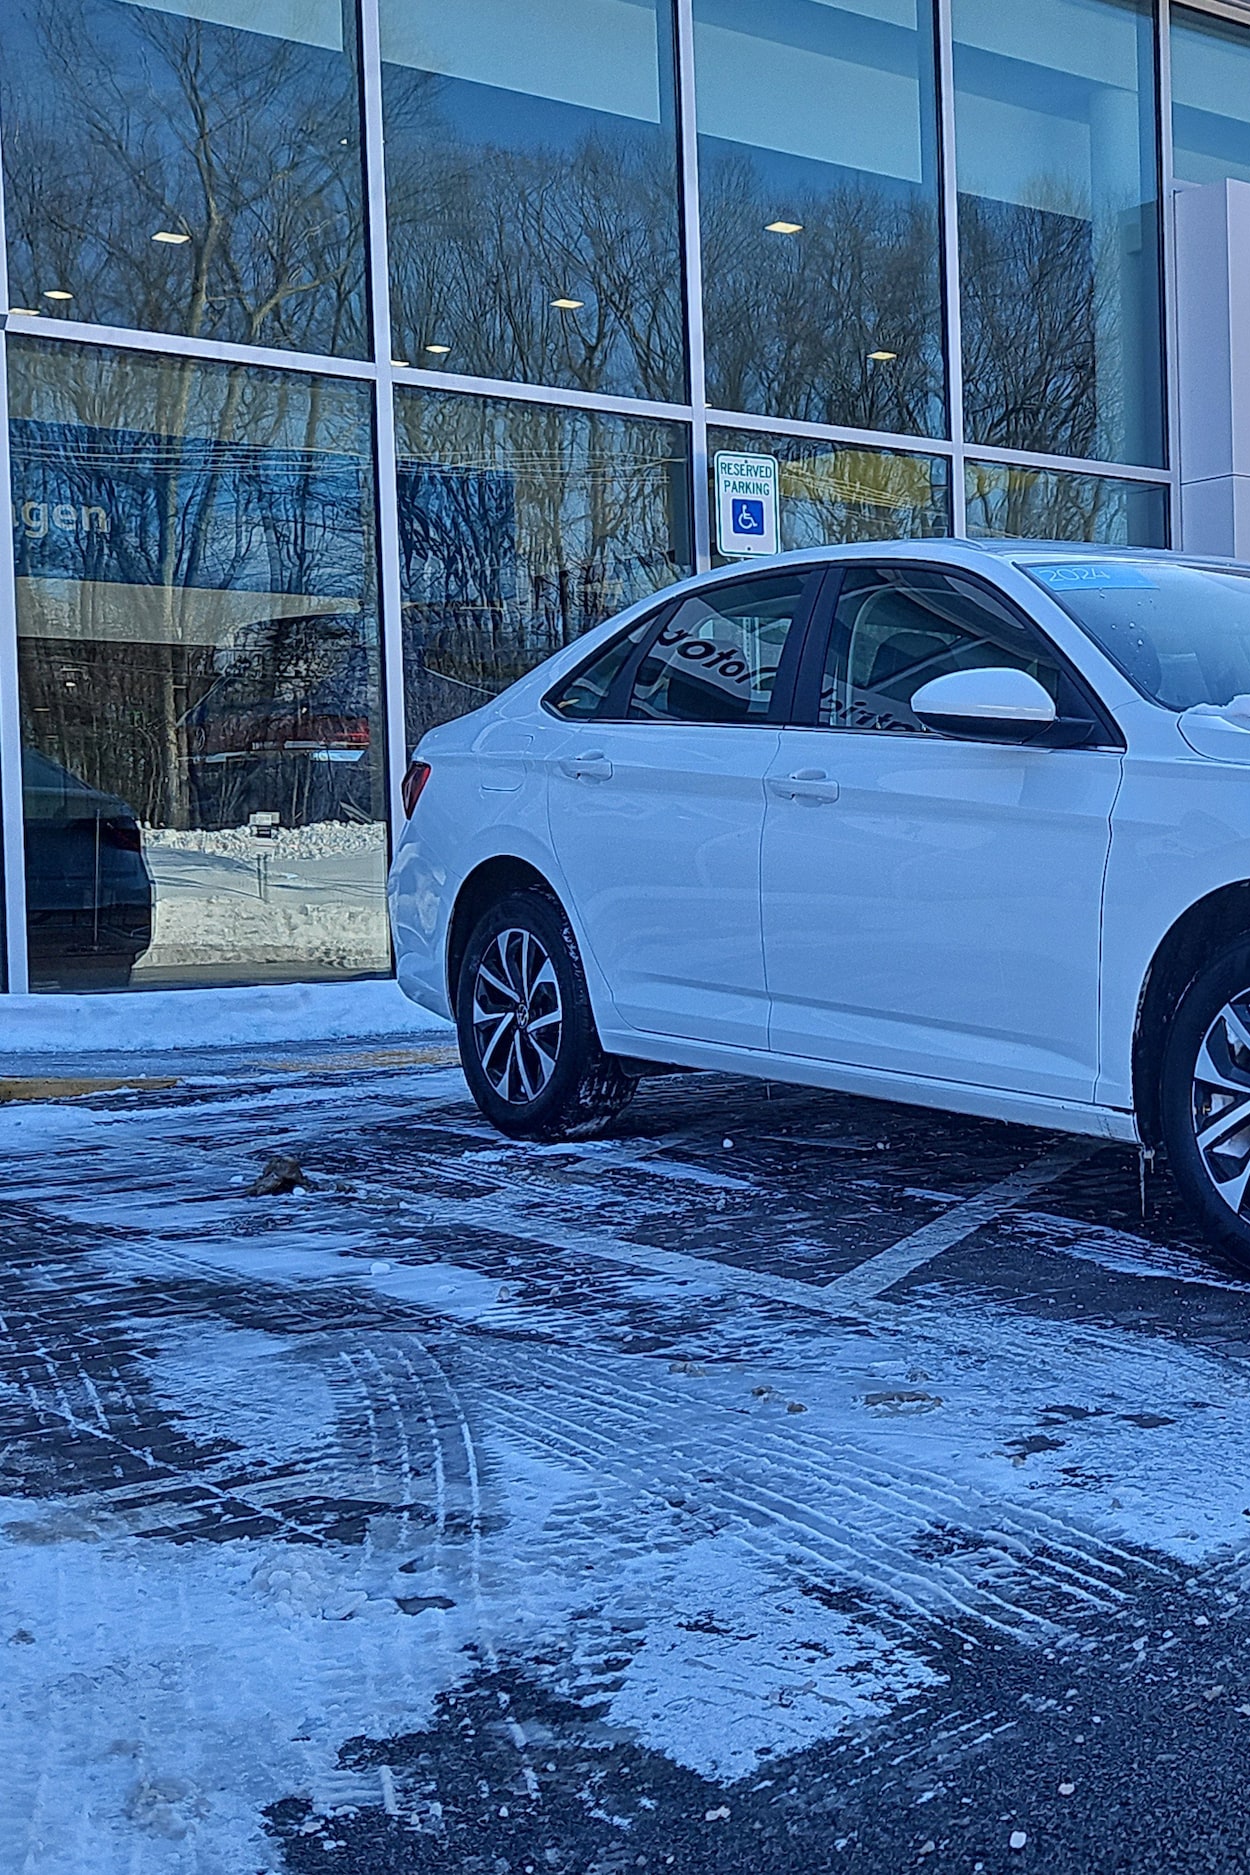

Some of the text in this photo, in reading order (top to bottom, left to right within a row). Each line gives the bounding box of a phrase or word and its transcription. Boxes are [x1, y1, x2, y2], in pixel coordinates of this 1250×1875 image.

[720, 462, 772, 479] RESERVED
[724, 479, 770, 496] PARKING
[12, 501, 107, 539] gen
[1040, 567, 1111, 582] 2024
